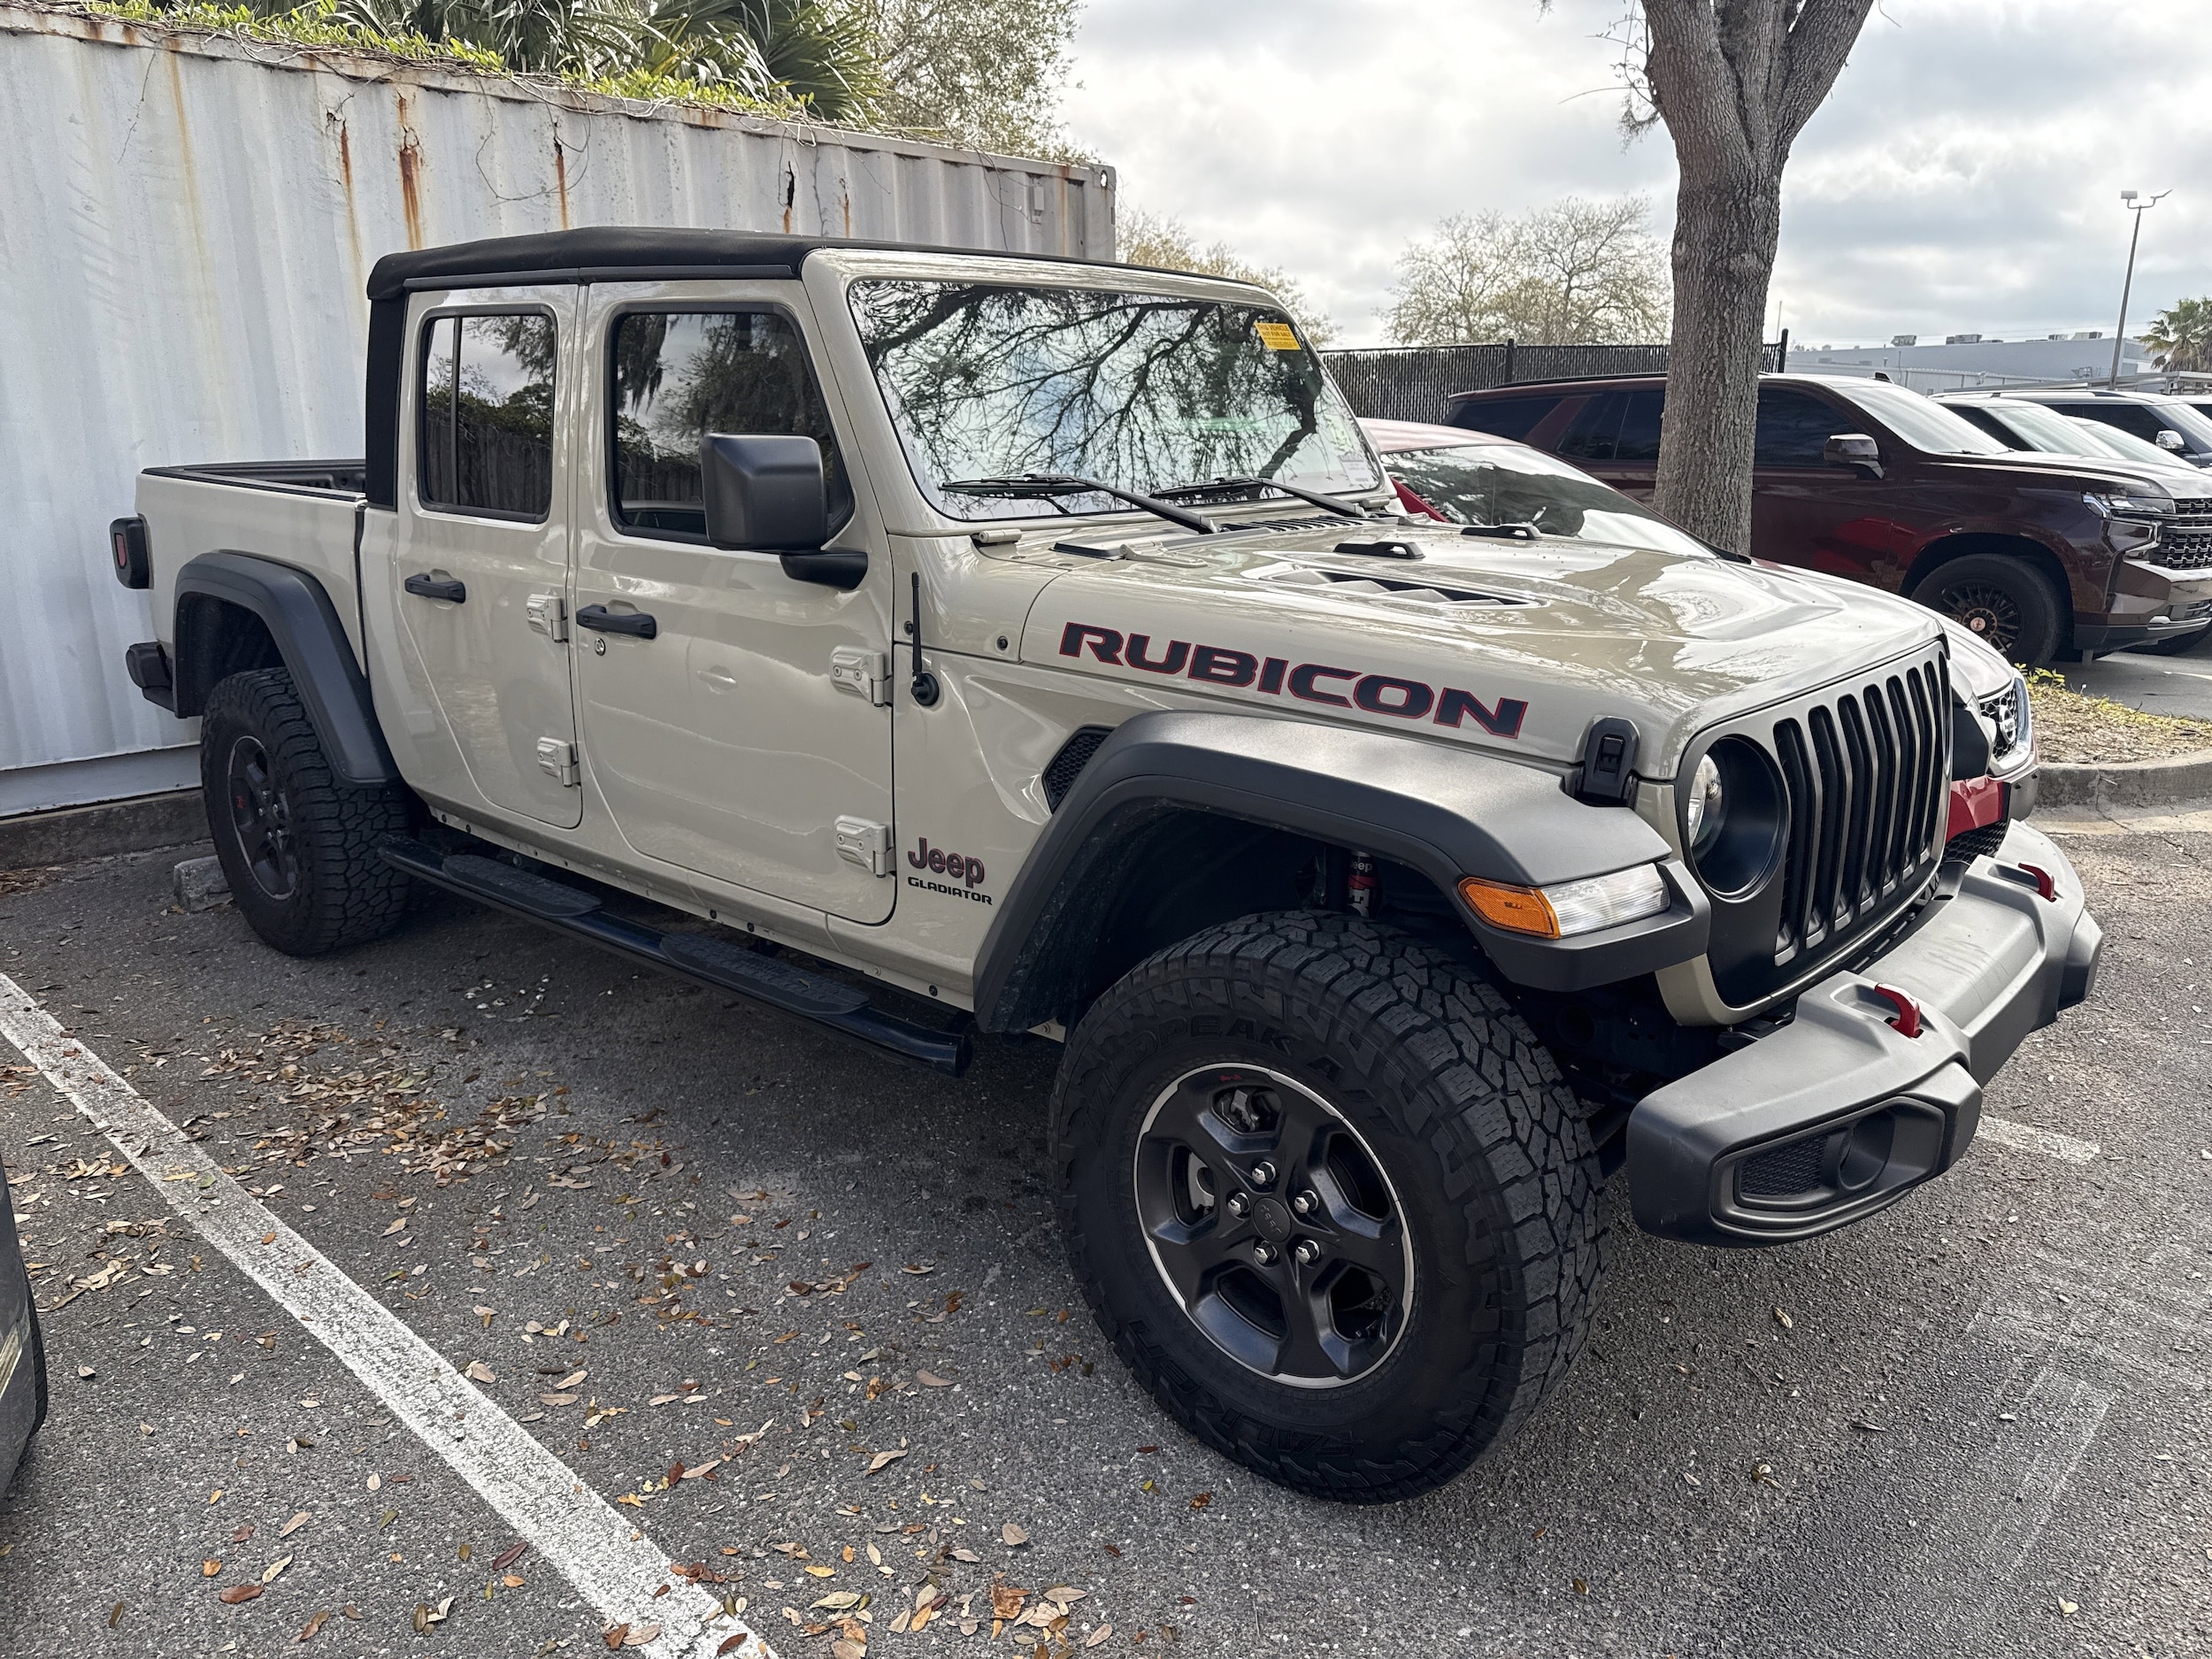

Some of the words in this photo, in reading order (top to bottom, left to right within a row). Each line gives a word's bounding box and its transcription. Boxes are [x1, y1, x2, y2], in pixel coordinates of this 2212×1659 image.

[1059, 621, 1529, 740] RUBICON
[907, 837, 985, 888] Jeep
[1350, 860, 1373, 873] eep
[907, 876, 993, 905] GLADIATOR
